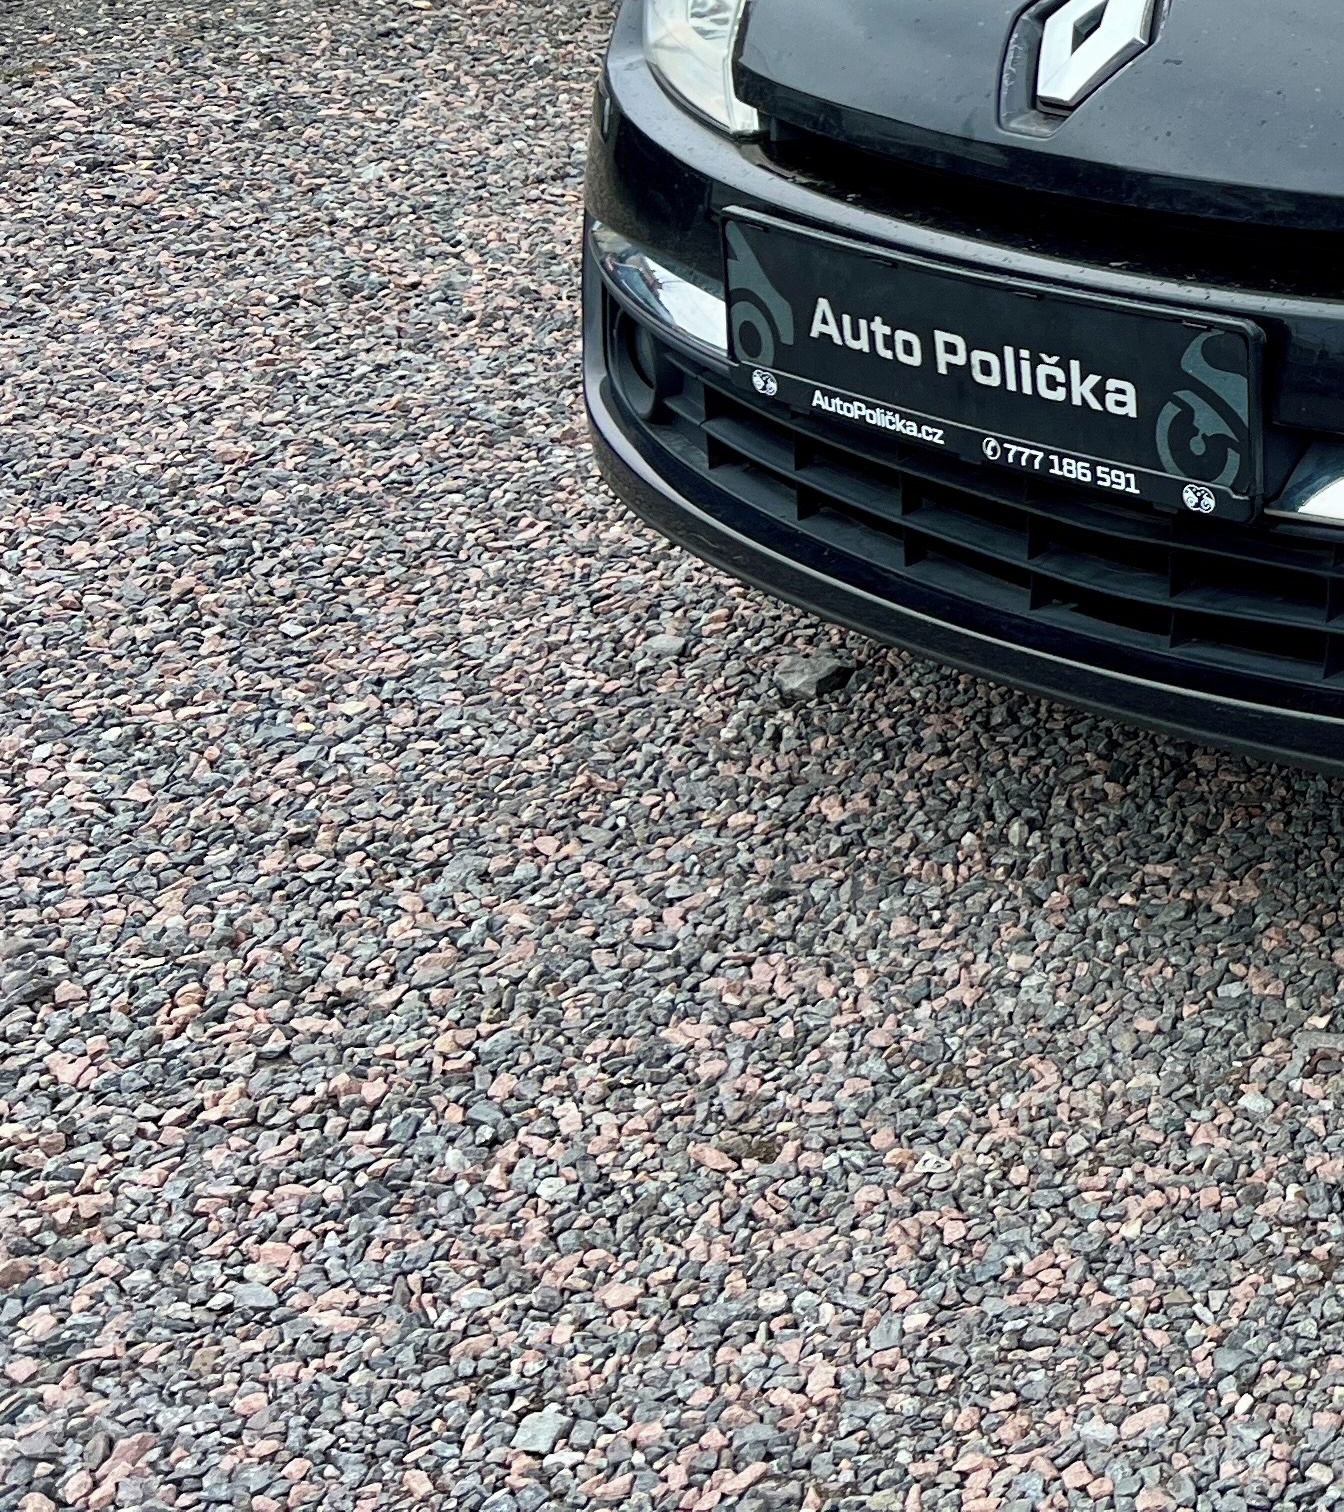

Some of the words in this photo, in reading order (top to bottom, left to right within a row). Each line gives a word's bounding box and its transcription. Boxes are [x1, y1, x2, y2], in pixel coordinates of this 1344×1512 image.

[809, 297, 922, 368] Auto
[935, 330, 1138, 418] Polička
[811, 390, 945, 445] AutoPolička.cz
[1003, 443, 1044, 469] 777
[1049, 456, 1092, 482] 186
[1095, 468, 1140, 495] 591
